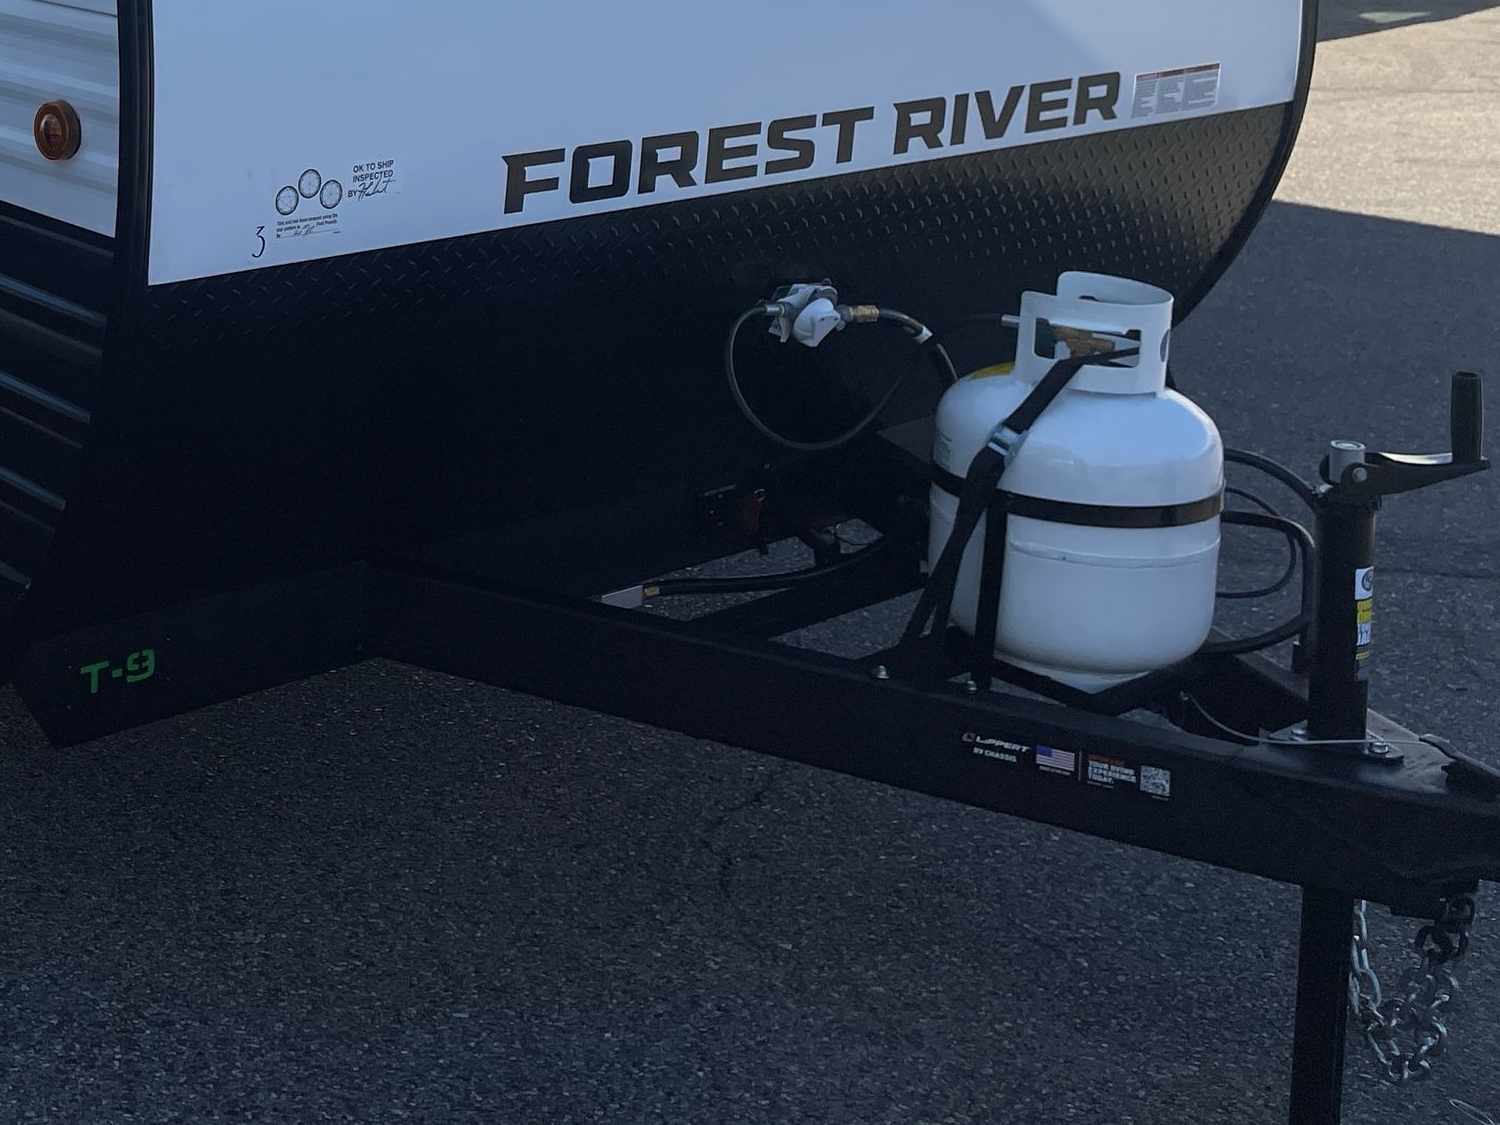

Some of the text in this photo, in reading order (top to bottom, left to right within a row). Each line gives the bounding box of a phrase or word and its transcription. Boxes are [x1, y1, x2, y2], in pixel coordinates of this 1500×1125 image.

[501, 105, 875, 215] FOREST
[892, 71, 1121, 155] RIVER
[353, 160, 394, 173] OK TO SHIP
[353, 170, 393, 183] INSPECTED
[348, 190, 358, 198] BY
